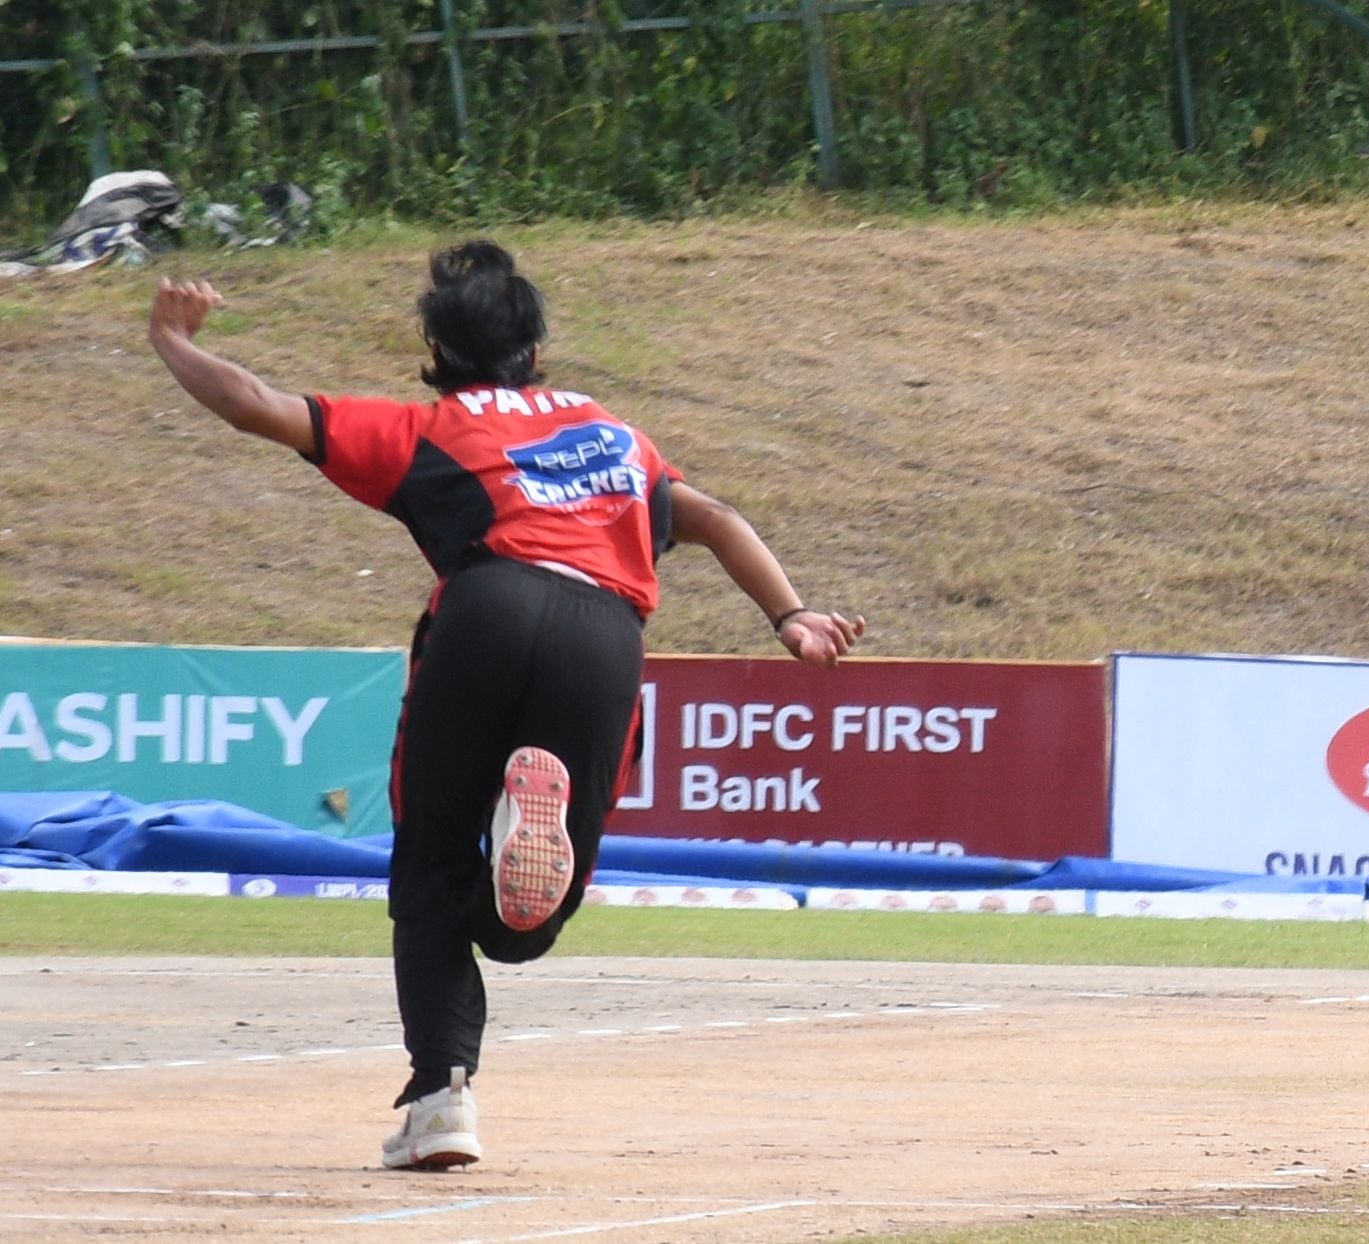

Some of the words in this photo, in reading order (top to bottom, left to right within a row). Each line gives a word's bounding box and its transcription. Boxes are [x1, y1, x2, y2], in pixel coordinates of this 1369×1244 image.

[518, 464, 648, 505] CRICKET
[0, 692, 330, 766] ASHIFY
[681, 703, 814, 751] IDFC
[832, 705, 997, 753] FIRST
[680, 765, 822, 812] Bank
